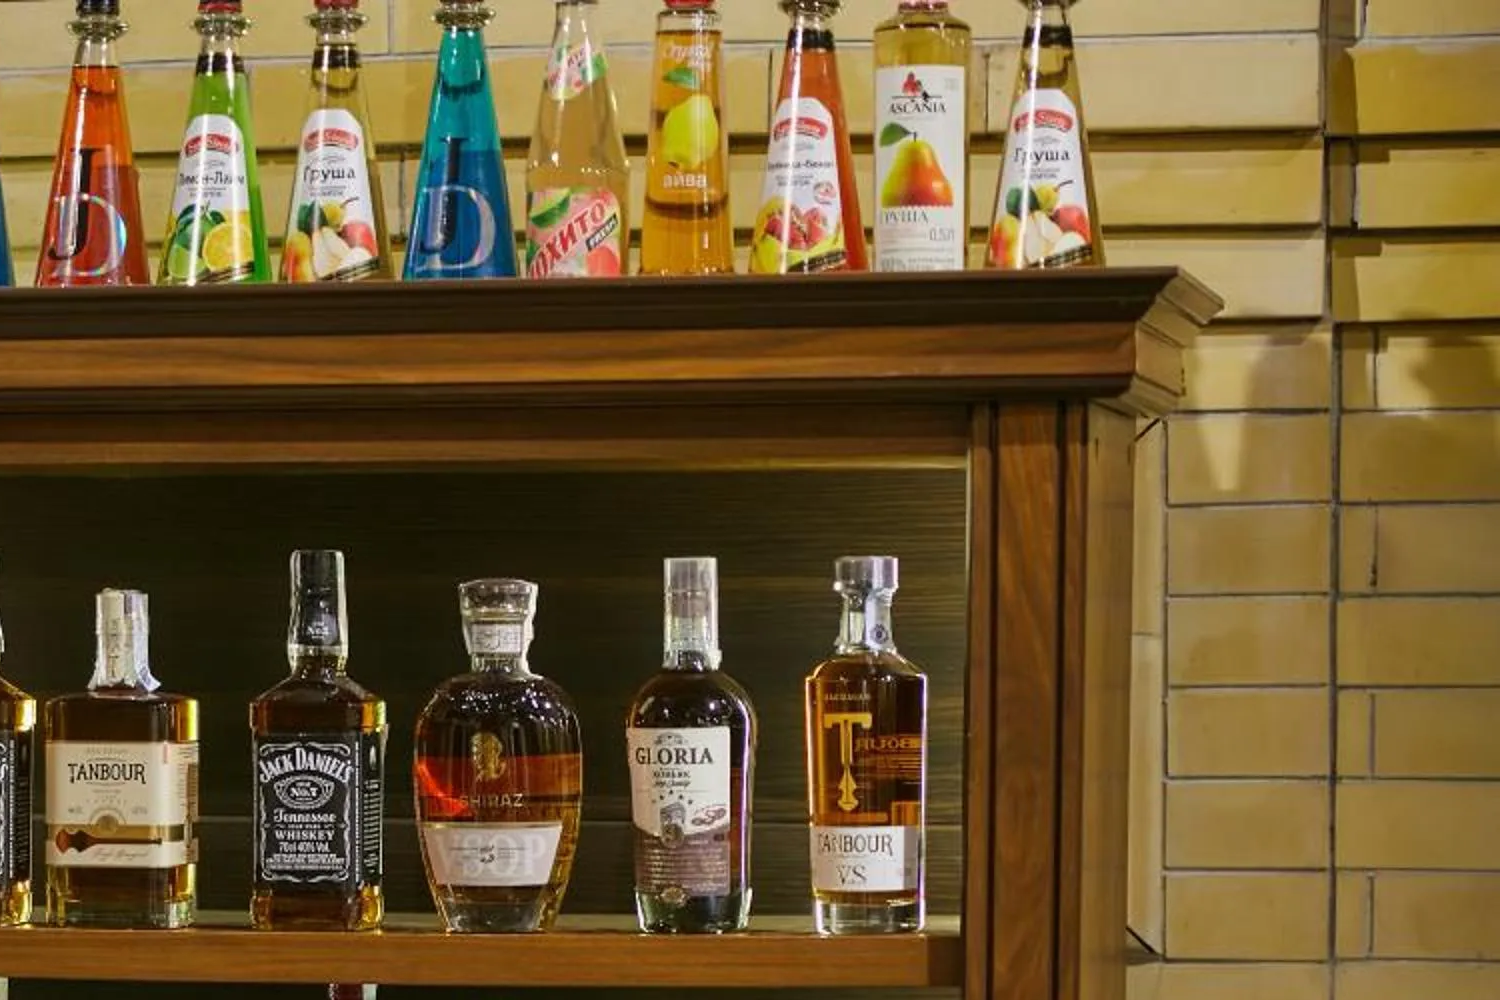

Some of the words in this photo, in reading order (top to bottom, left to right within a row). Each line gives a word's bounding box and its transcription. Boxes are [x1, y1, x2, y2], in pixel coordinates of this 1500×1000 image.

[889, 101, 946, 114] ASCANIA
[303, 166, 356, 182] Груша
[529, 202, 606, 279] ОХИТО
[259, 755, 293, 783] JACK
[295, 747, 354, 783] DANIEL'S
[635, 747, 714, 765] GLORIA
[68, 762, 146, 784] TANBOUR
[275, 829, 334, 840] WHISKEY
[817, 832, 893, 857] TANBOUR
[836, 864, 868, 885] VS
